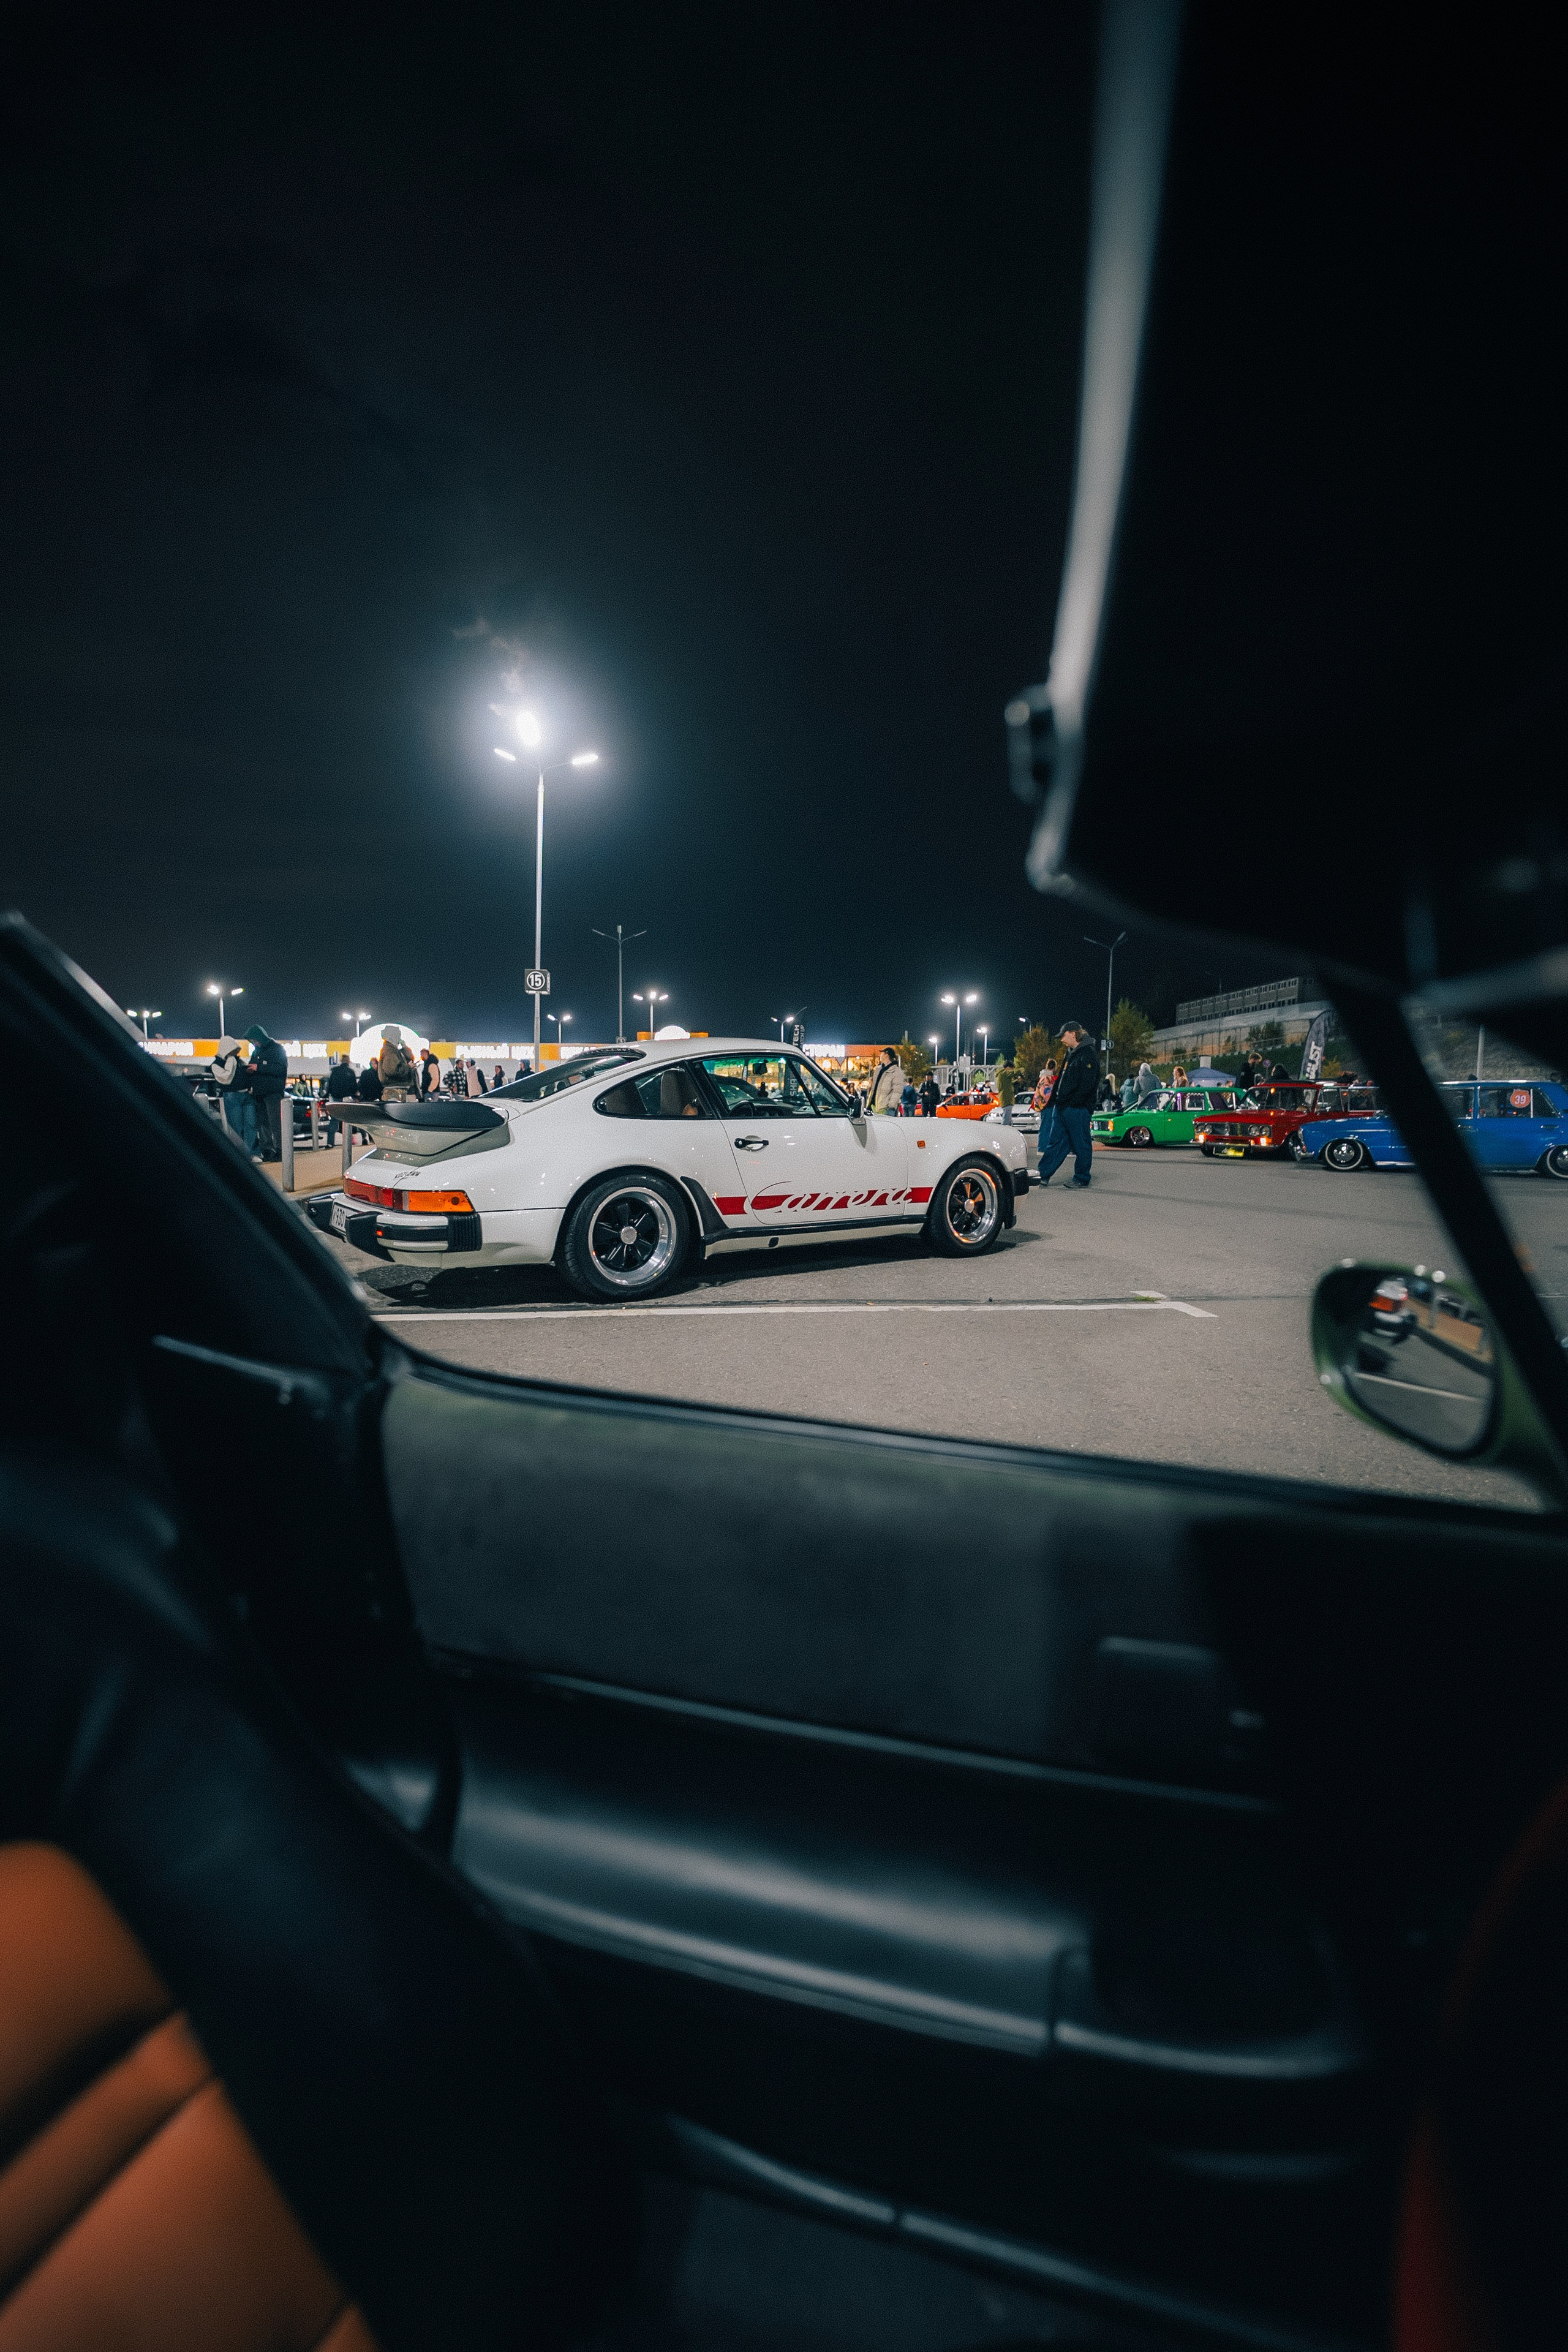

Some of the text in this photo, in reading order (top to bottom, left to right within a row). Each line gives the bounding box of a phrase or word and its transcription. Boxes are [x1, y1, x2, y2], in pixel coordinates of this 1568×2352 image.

[529, 974, 542, 987] 15
[1515, 1095, 1526, 1104] 39
[743, 1181, 913, 1213] Carrera
